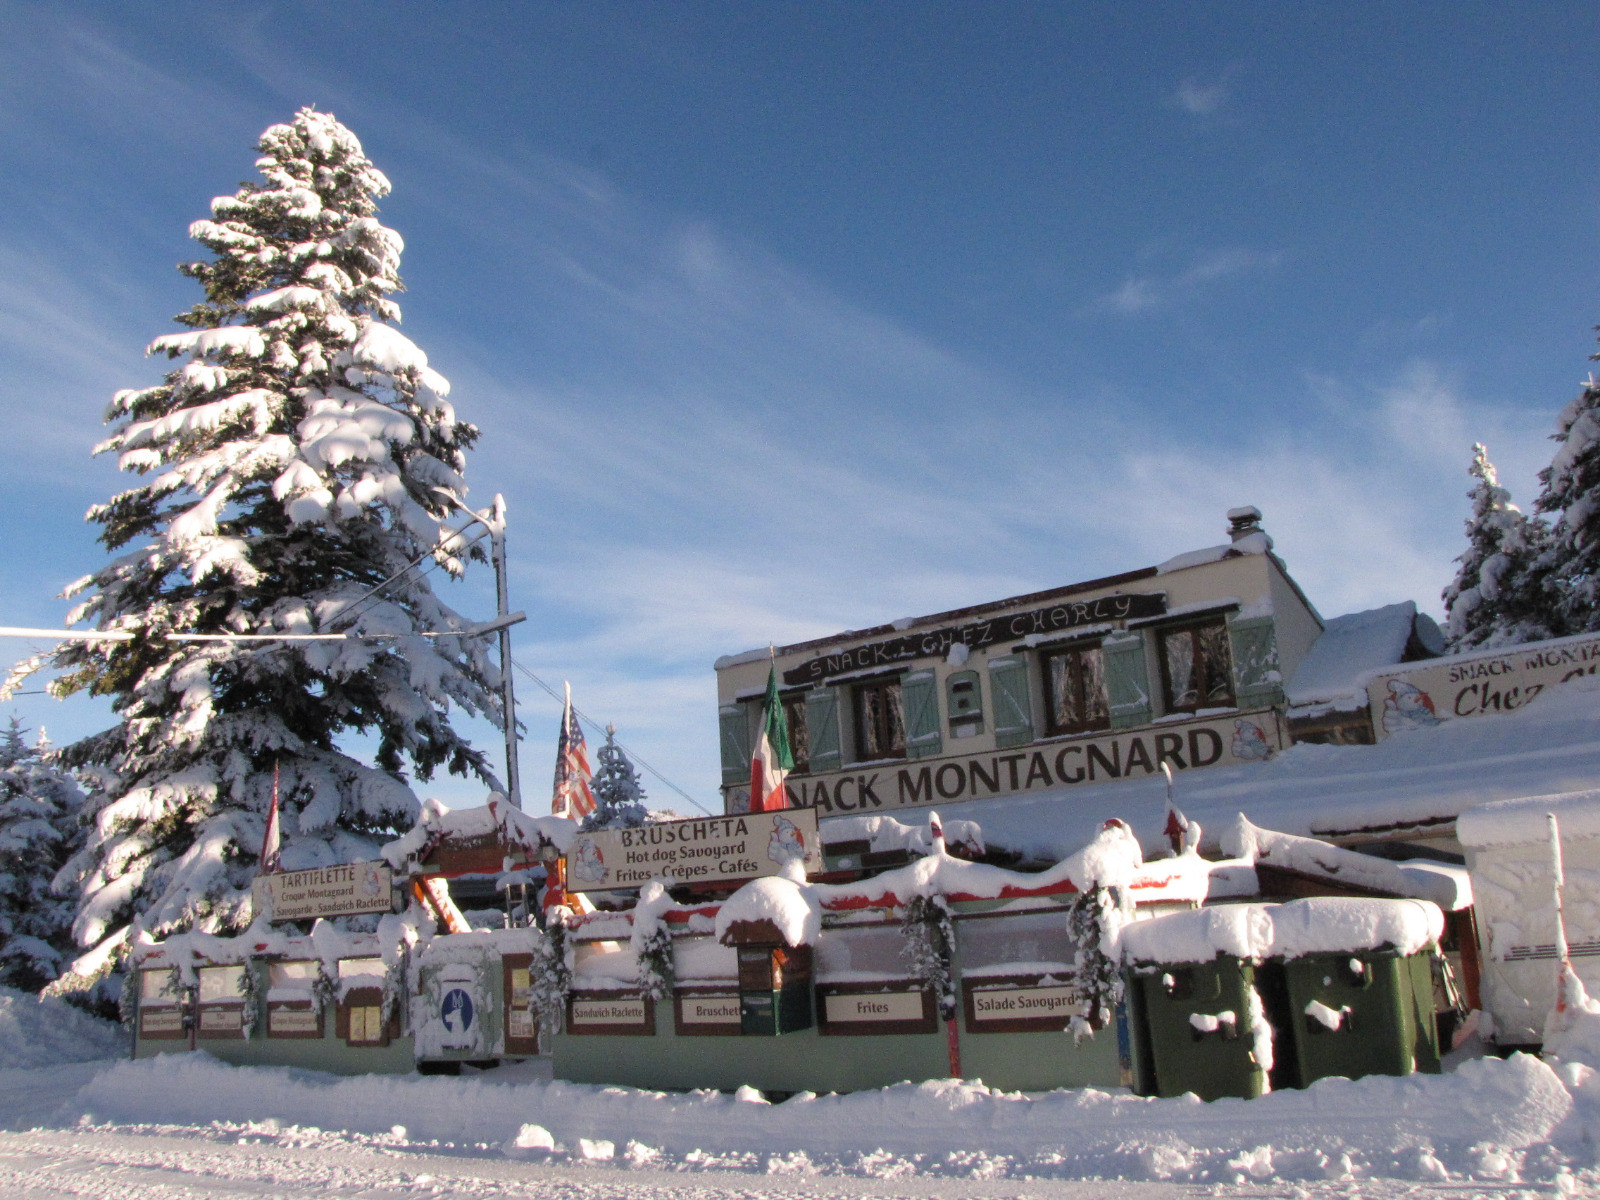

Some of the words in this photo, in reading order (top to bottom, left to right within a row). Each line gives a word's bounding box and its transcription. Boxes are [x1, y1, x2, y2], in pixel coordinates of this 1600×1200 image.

[810, 645, 891, 677] SNACK
[1011, 597, 1131, 636] CHARLY
[1449, 661, 1515, 683] SNACK
[1454, 681, 1545, 717] Chez
[785, 773, 882, 812] NACK
[897, 727, 1224, 804] MONTAGNARD
[622, 818, 749, 847] BRUSCHETA
[626, 851, 650, 864] Hot
[652, 848, 677, 864] dog
[679, 841, 746, 860] Savoyard
[281, 867, 355, 888] TARTIFLETTE
[616, 867, 651, 882] Frites
[662, 864, 708, 880] Crêpes
[718, 859, 758, 874] Cafés
[282, 891, 306, 902] Croque
[307, 885, 354, 899] Montagnard
[319, 899, 354, 912] Sandwich
[356, 898, 390, 909] Raclette
[575, 1008, 610, 1018] Sandwich
[611, 1007, 643, 1017] Raclette
[857, 1001, 889, 1014] Frites
[977, 997, 1015, 1011] Salade
[1018, 995, 1081, 1010] Savoyard
